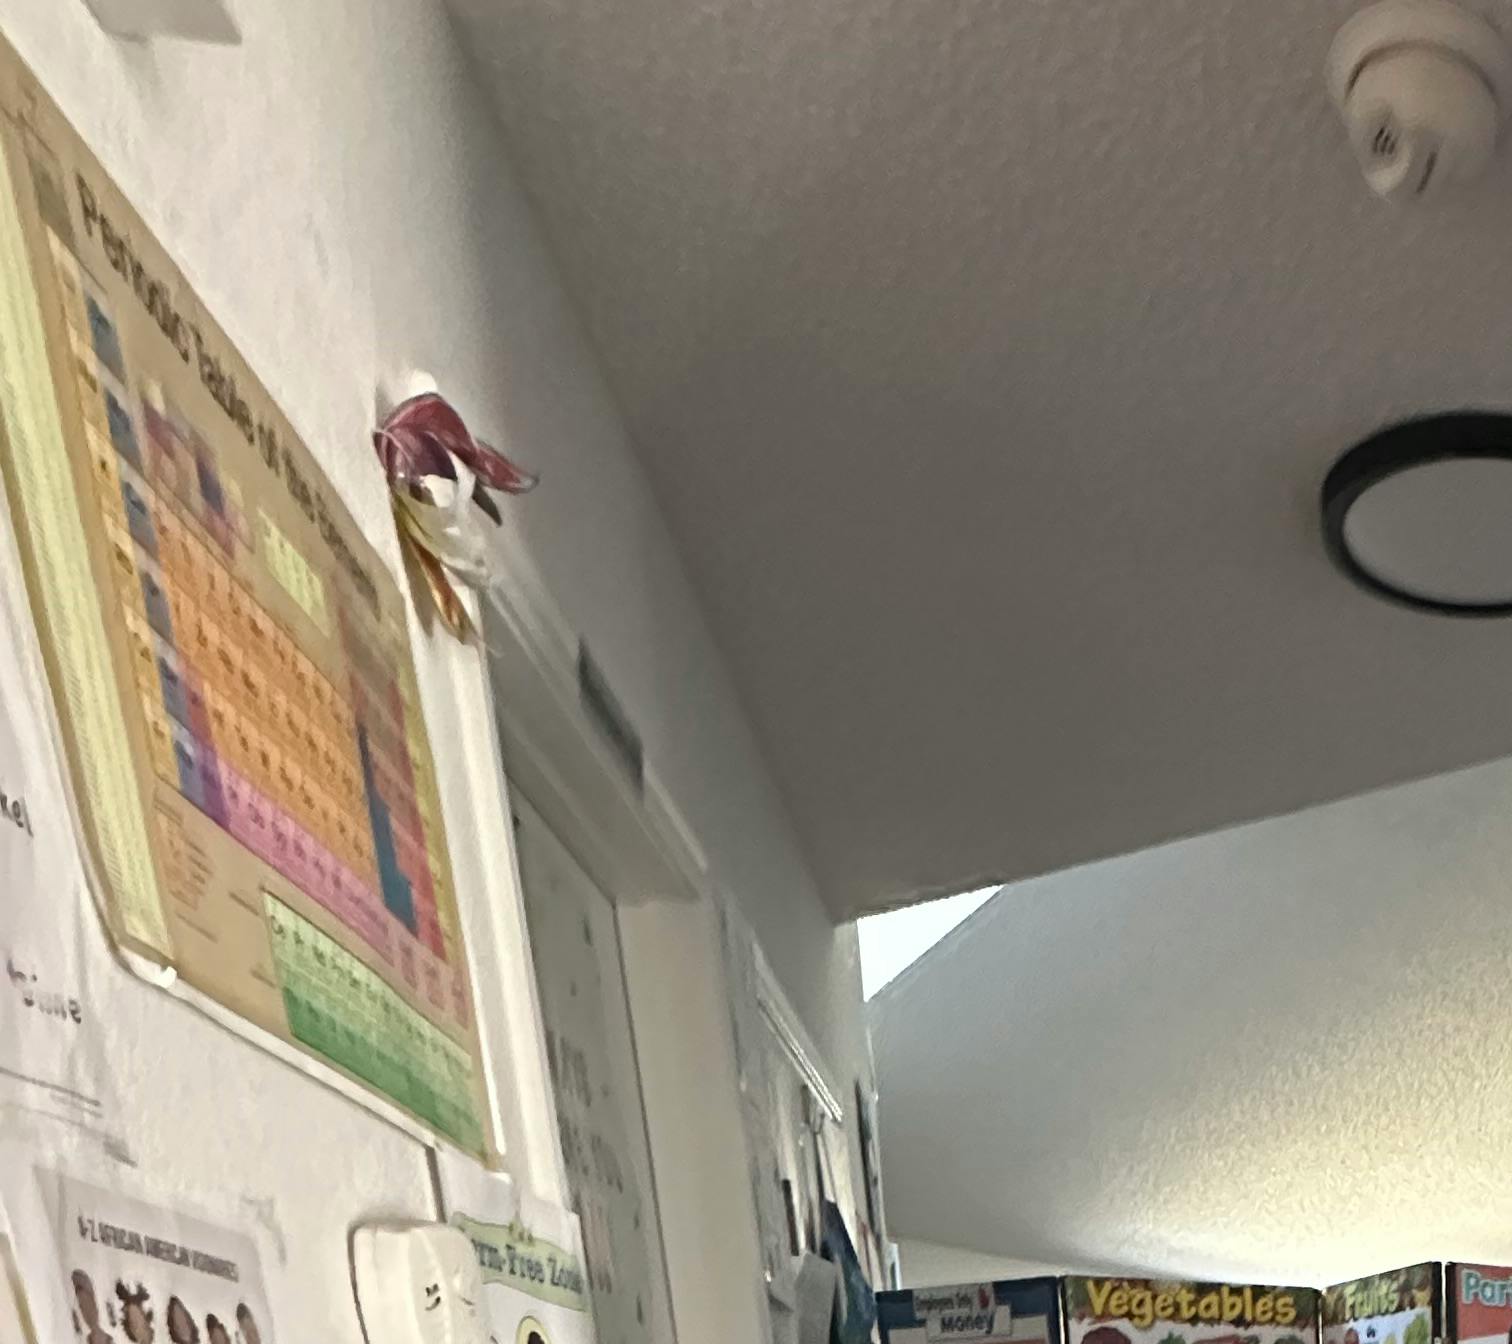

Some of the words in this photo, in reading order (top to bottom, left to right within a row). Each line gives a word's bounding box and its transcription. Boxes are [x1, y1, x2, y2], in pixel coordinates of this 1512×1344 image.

[472, 1240, 545, 1285] rm-Free
[1087, 1278, 1297, 1330] Vegetables
[1343, 1276, 1399, 1321] Fruits
